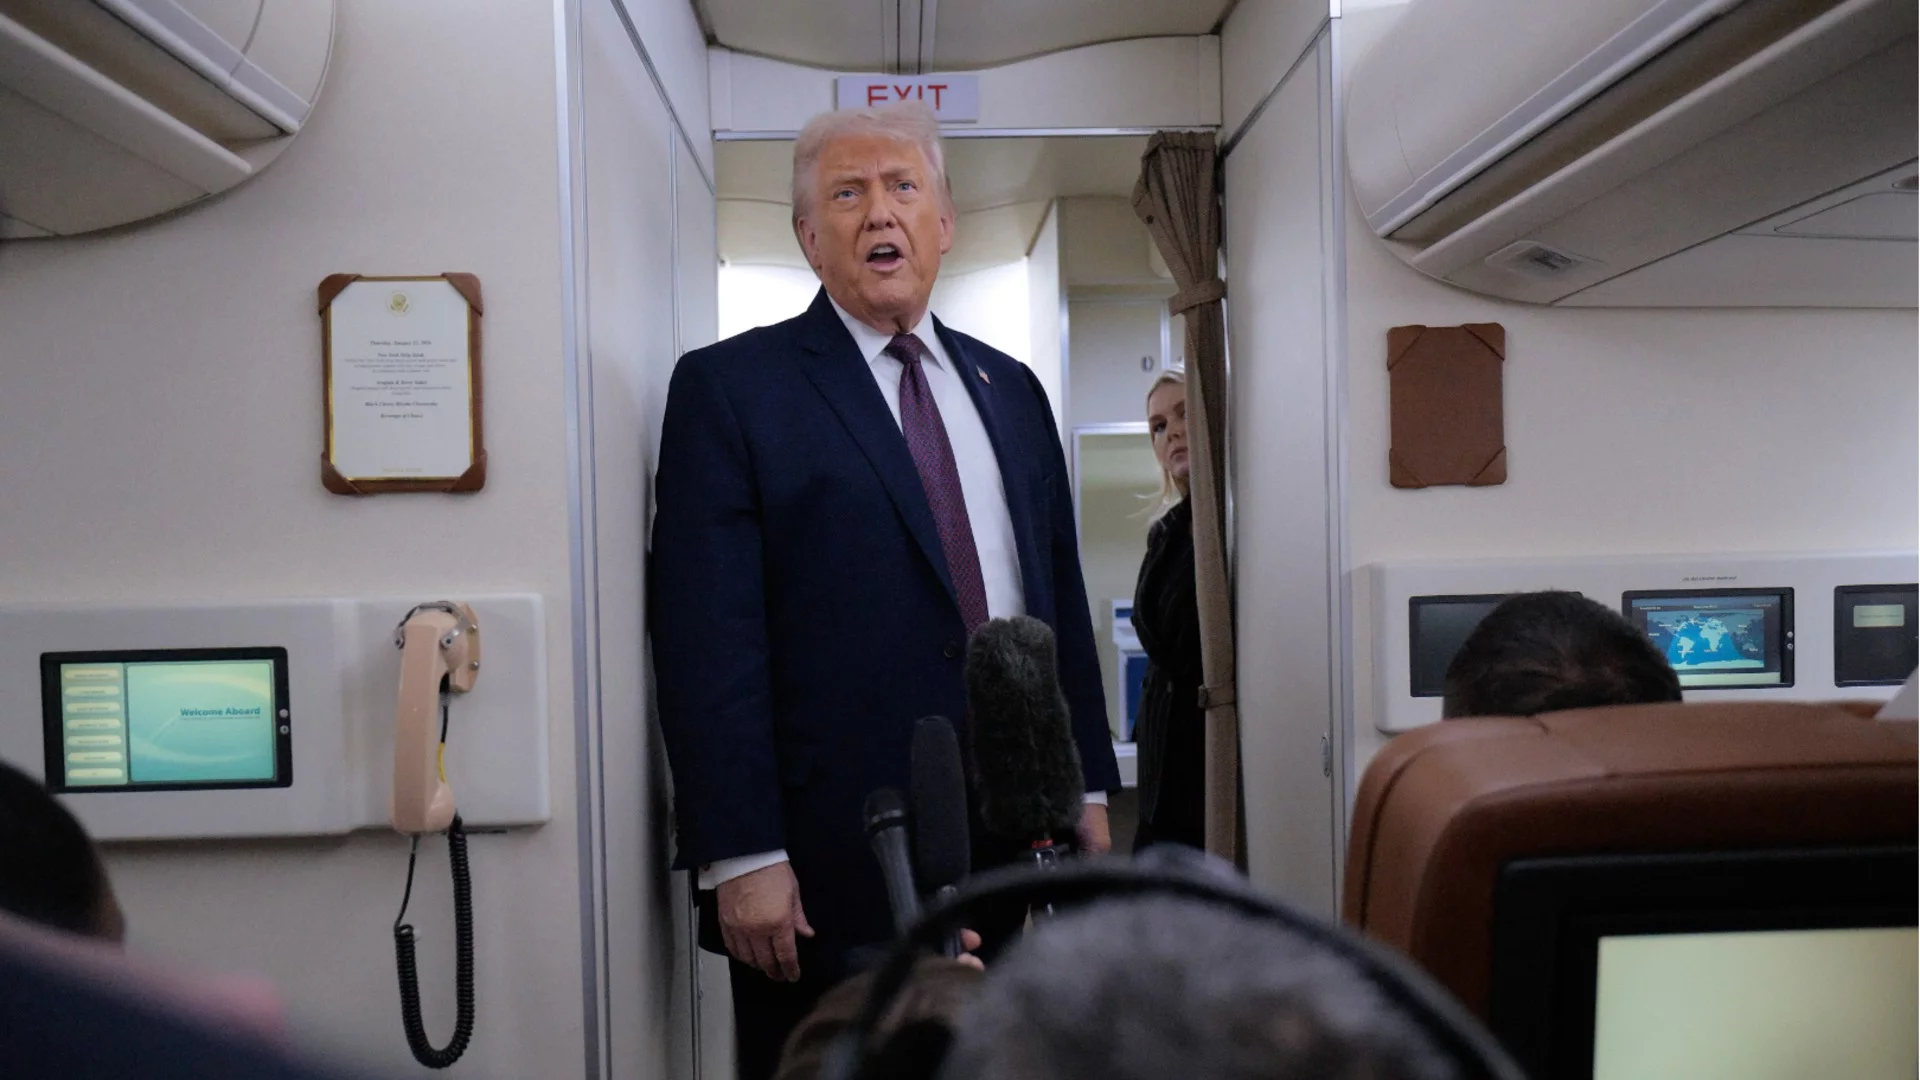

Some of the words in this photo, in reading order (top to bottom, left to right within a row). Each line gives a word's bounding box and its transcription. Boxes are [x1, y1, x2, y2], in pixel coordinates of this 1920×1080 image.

[867, 84, 948, 111] EXIT
[180, 708, 223, 716] Welcome
[225, 706, 261, 715] Aboard
